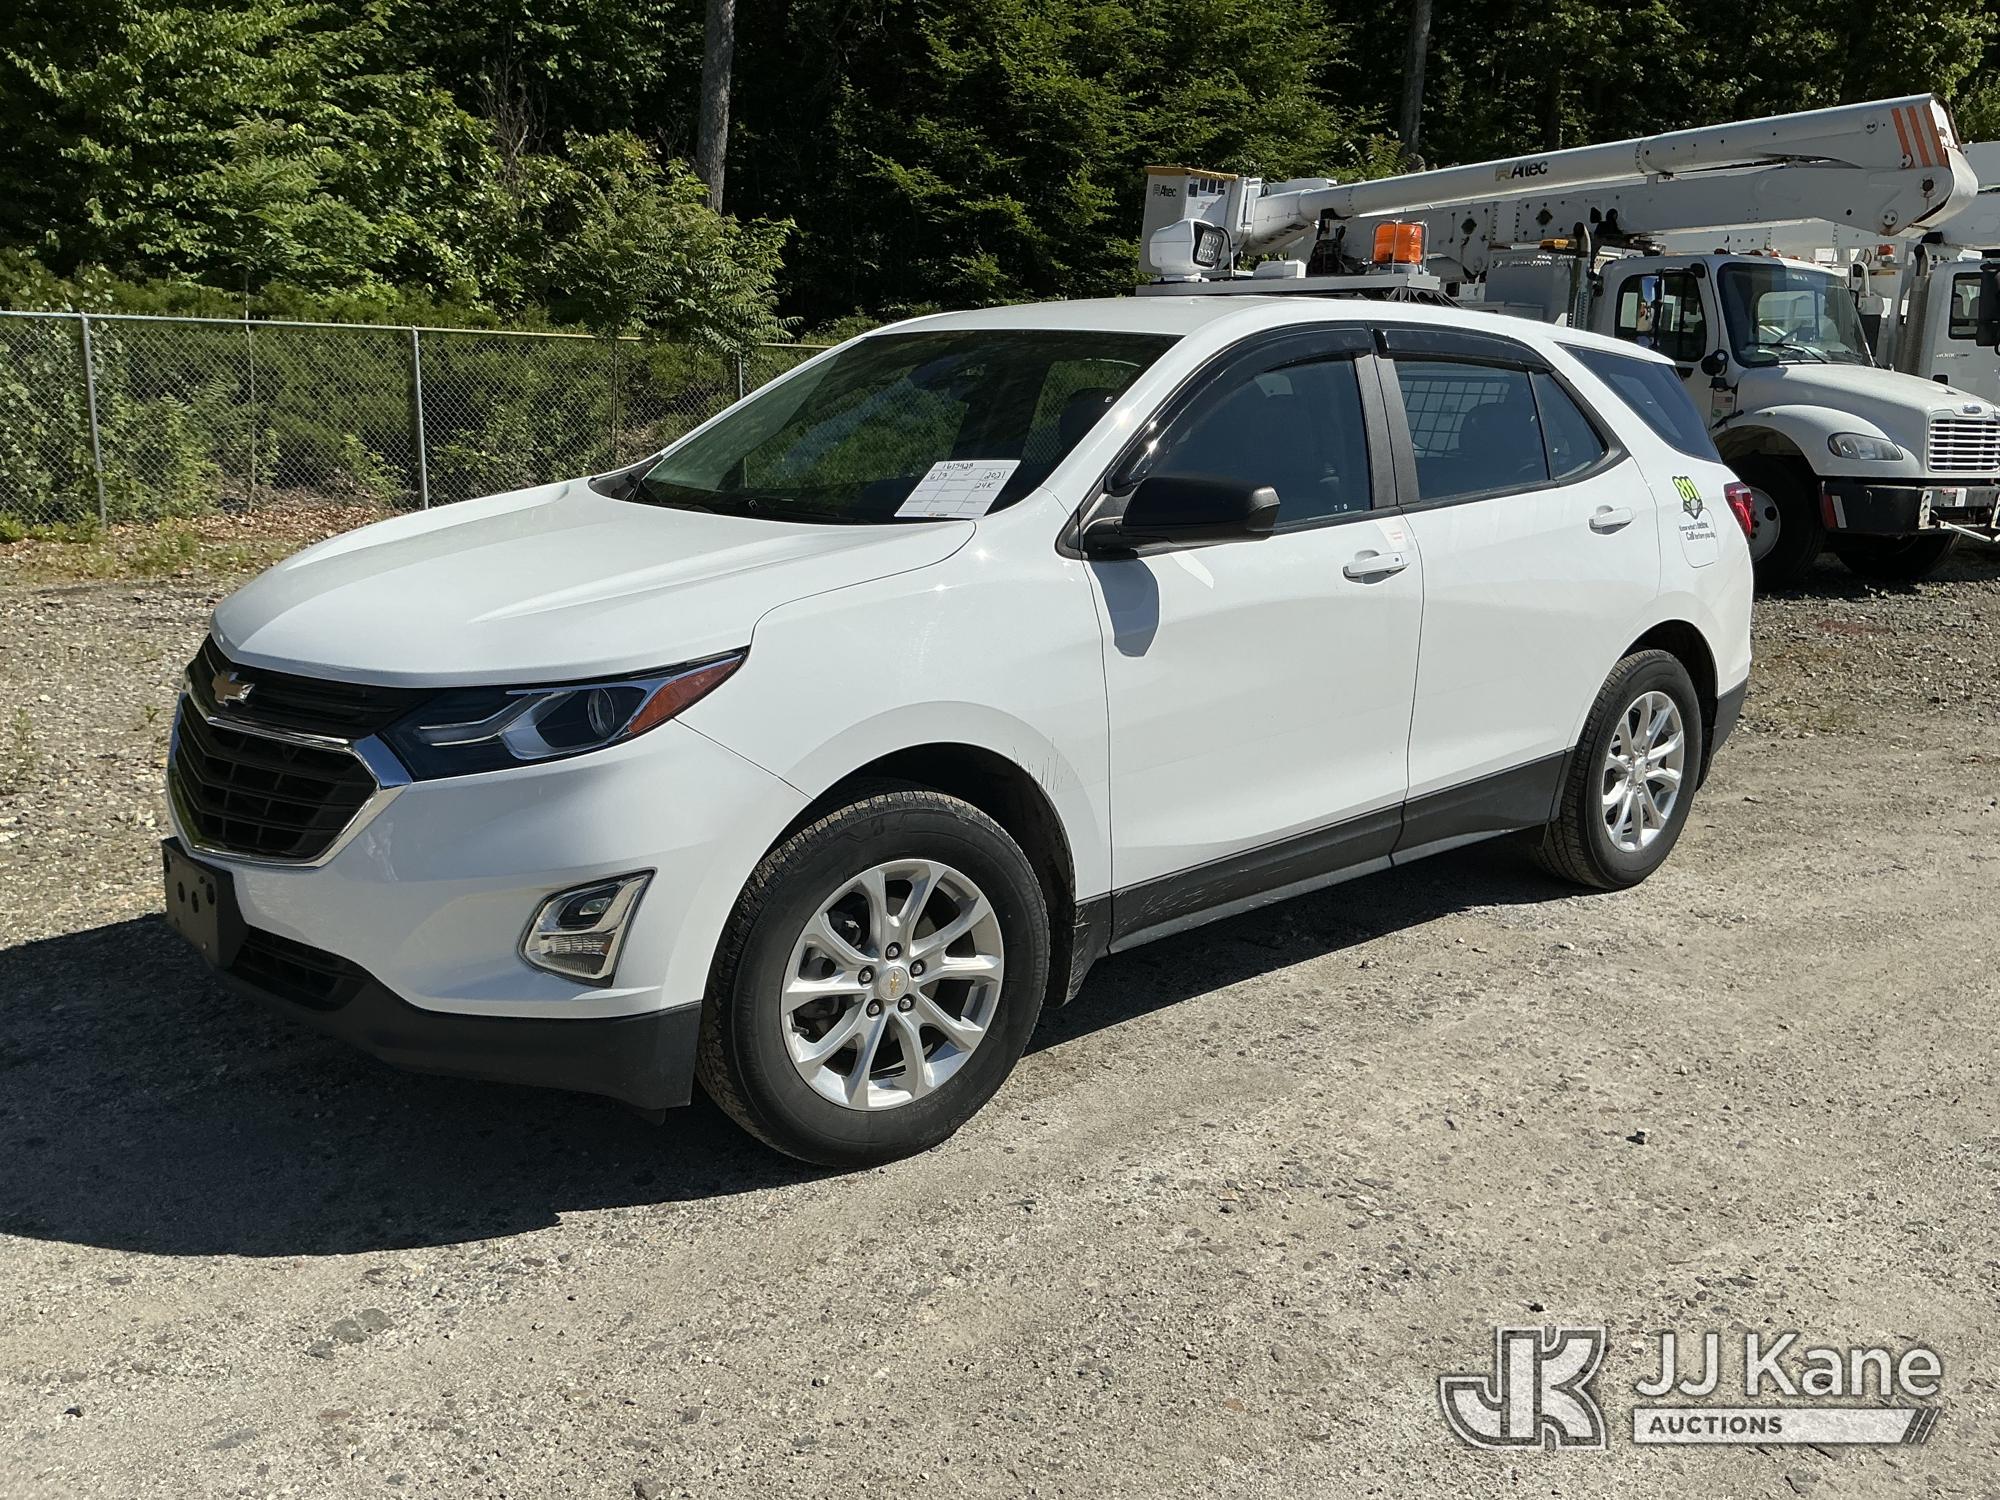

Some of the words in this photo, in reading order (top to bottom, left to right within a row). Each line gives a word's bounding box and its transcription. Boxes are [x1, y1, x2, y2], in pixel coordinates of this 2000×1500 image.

[1511, 161, 1548, 178] Altec
[1160, 185, 1176, 197] Altec
[1671, 476, 1702, 502] 811
